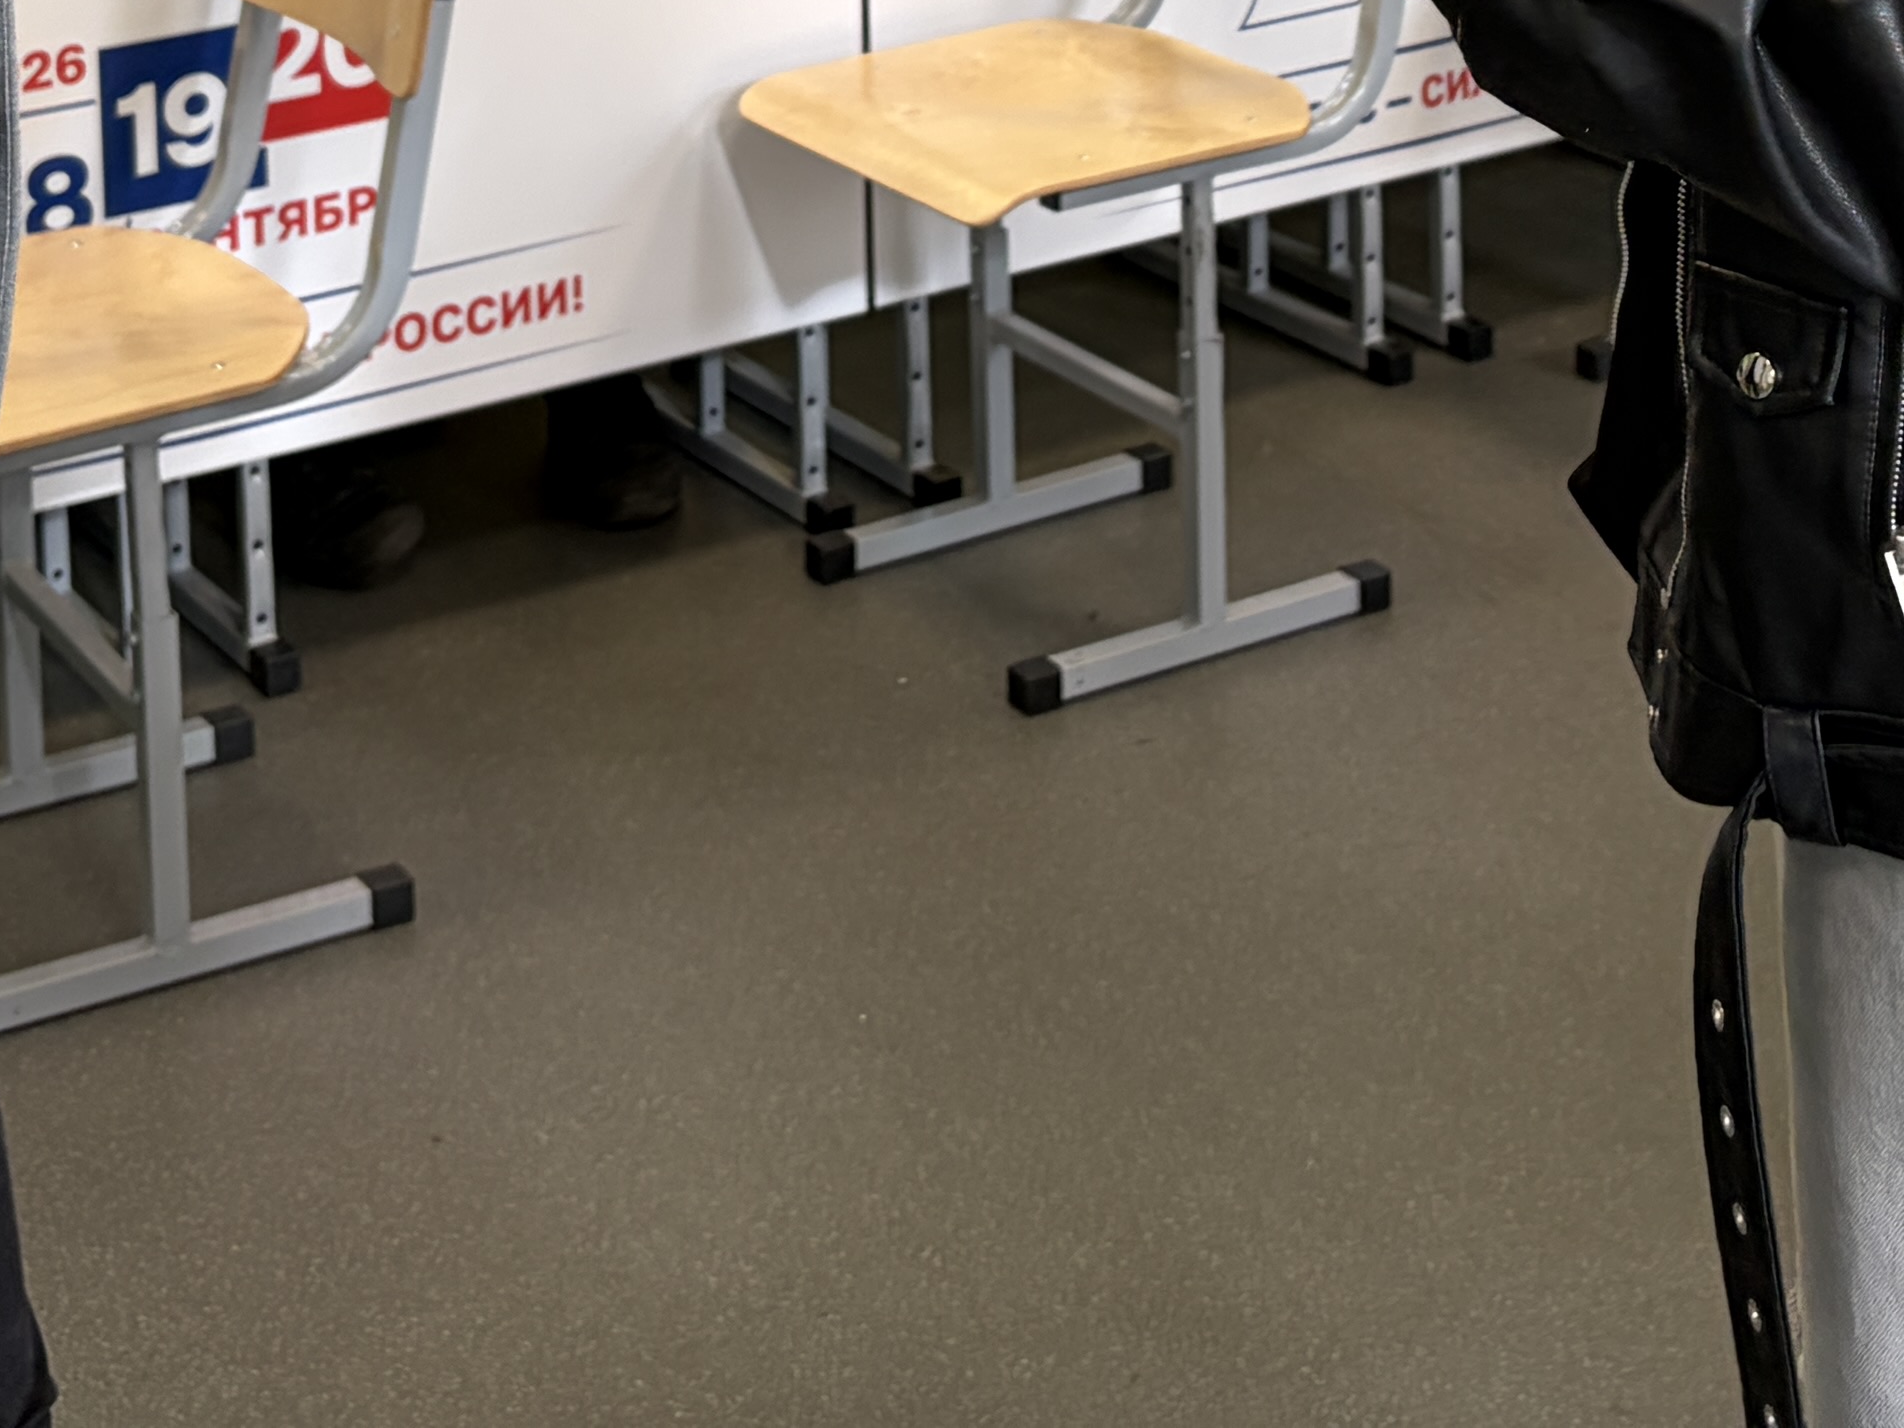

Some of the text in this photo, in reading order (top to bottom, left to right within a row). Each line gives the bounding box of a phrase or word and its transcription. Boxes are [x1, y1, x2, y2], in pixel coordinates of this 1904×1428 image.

[22, 43, 87, 93] 26
[115, 71, 228, 179] 19
[380, 274, 585, 354] ОССИИ!
